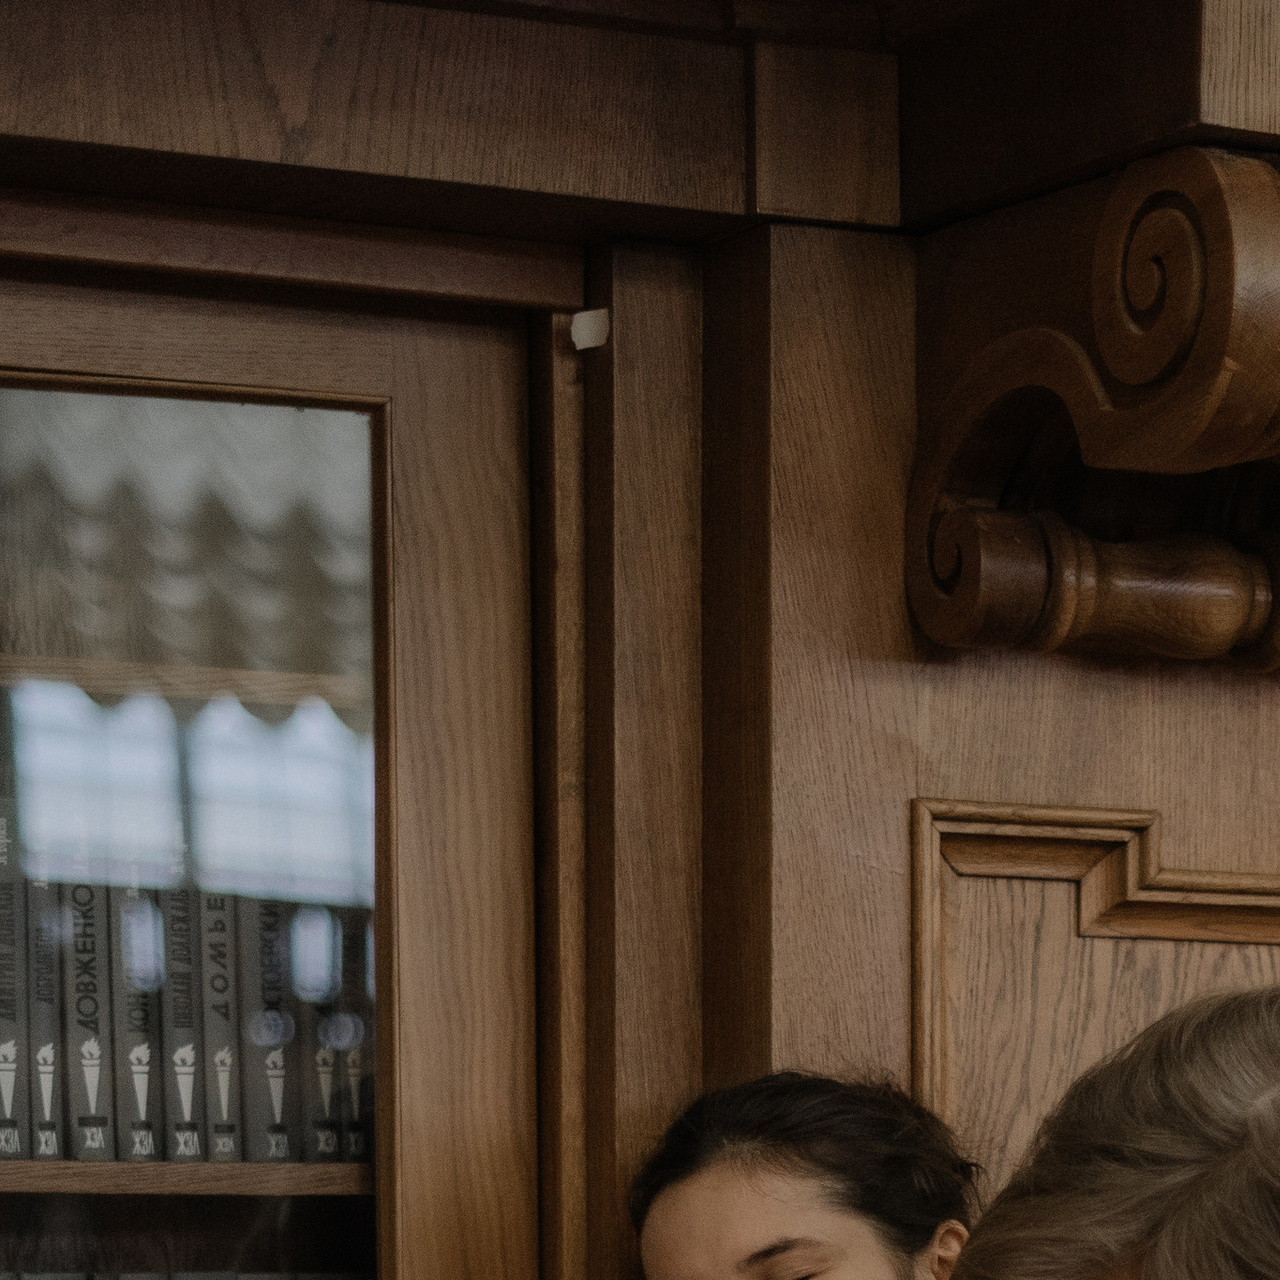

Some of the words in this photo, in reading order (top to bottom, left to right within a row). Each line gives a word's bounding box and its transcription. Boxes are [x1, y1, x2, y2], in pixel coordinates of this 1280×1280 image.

[71, 885, 99, 1035] ДОВЖЕНКО
[206, 897, 230, 1022] ДОМЬЕ
[39, 1131, 58, 1155] ЖЗЛ
[85, 1127, 105, 1149] ЖЗЛ
[132, 1131, 154, 1156] ЖЗЛ
[177, 1132, 200, 1156] ЖЗЛ
[215, 1137, 235, 1153] ЖЗЛ
[269, 1133, 289, 1157] ЖЗЛ
